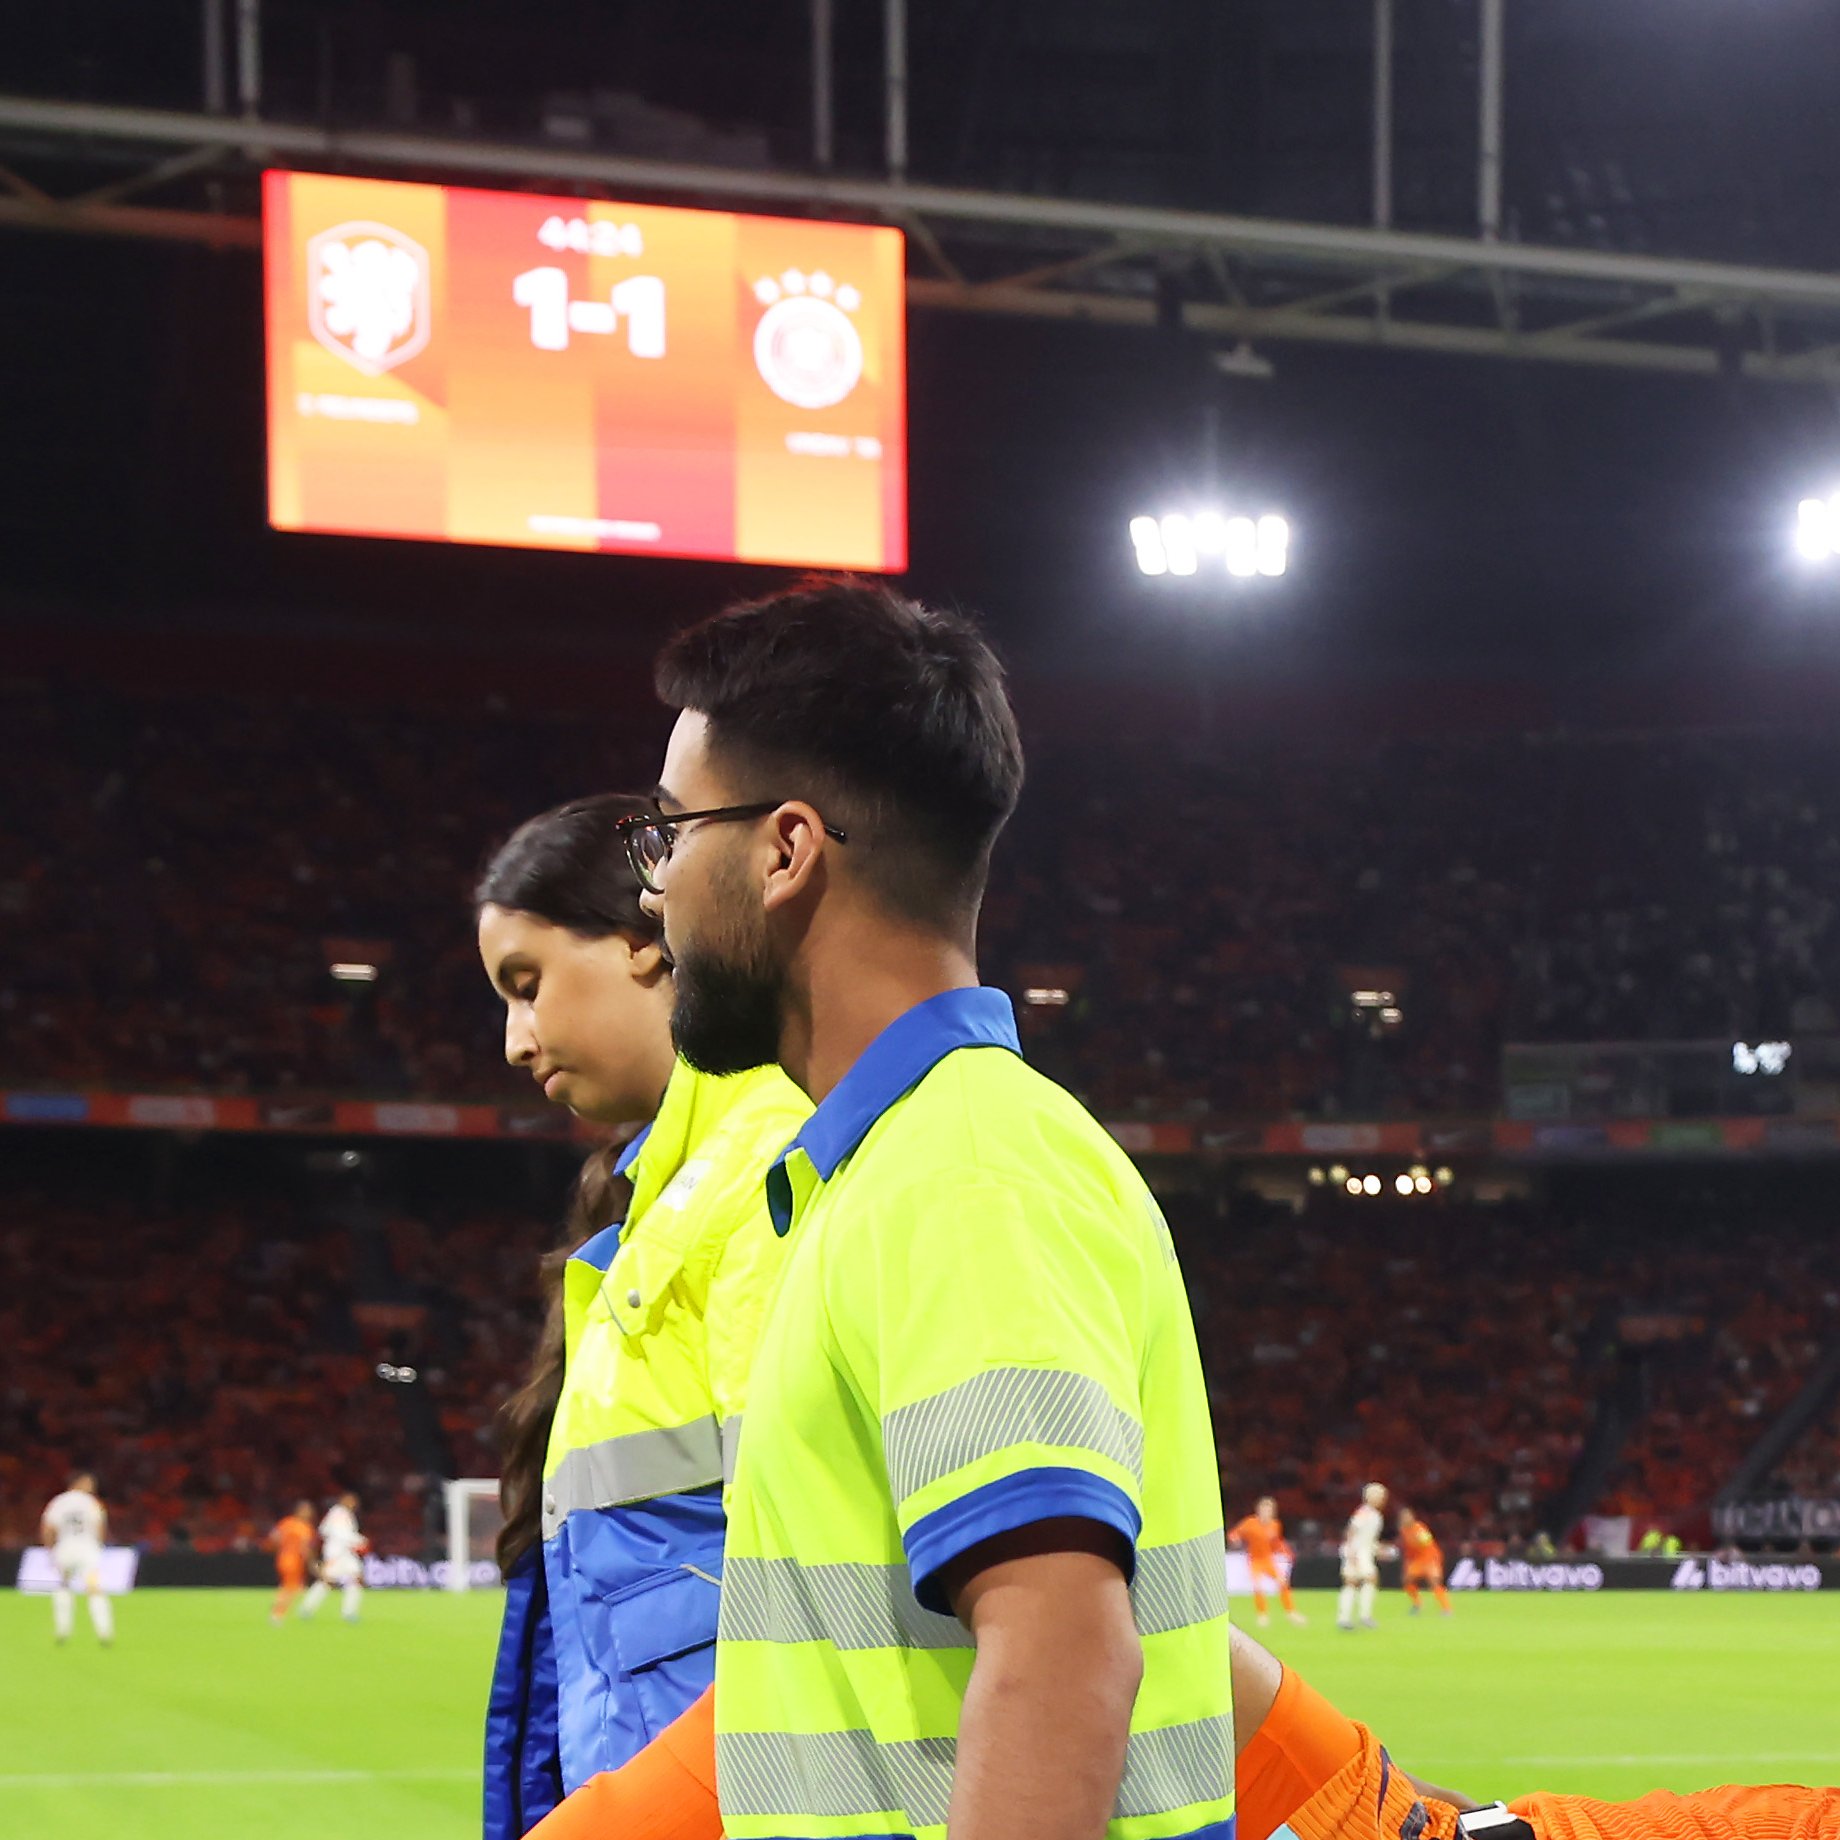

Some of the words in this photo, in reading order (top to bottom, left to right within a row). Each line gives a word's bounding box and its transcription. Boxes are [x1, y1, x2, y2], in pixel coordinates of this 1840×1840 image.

[512, 266, 666, 359] 1-1
[1483, 1557, 1604, 1591] bitvavo
[1706, 1558, 1822, 1591] bitvavo
